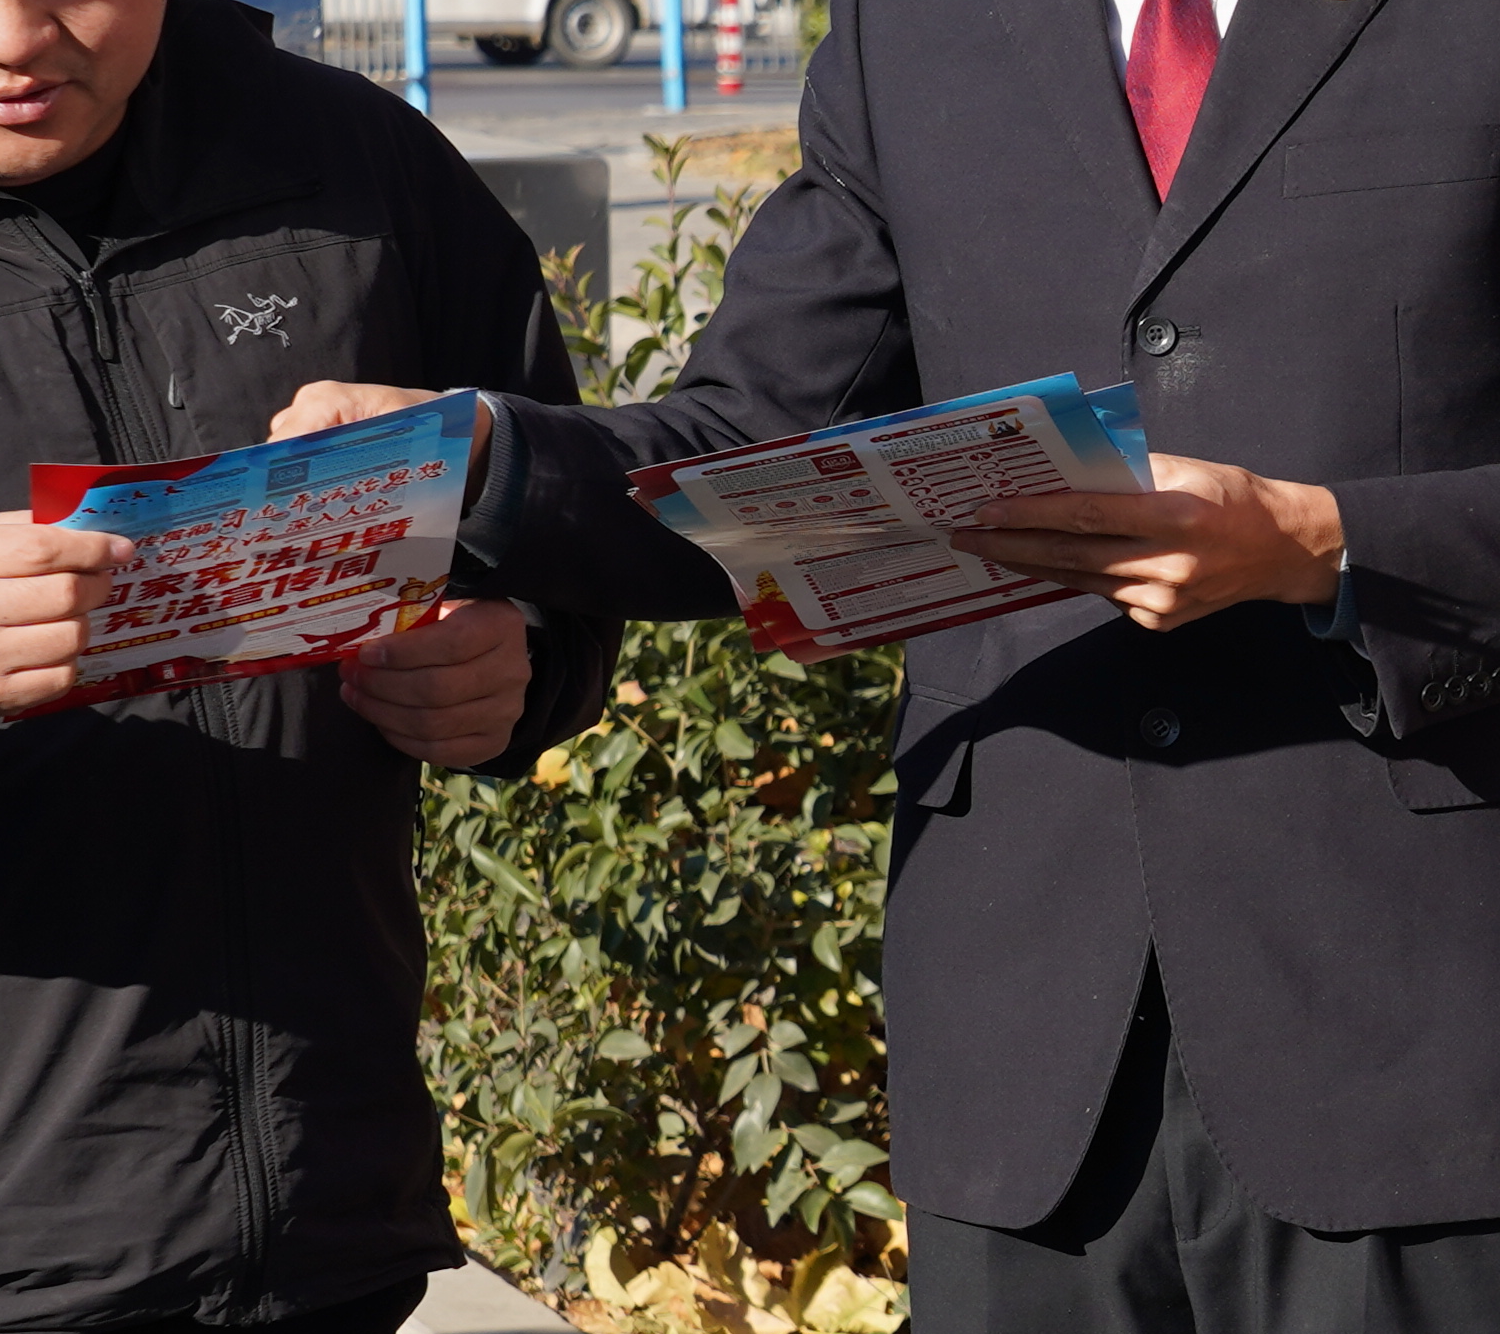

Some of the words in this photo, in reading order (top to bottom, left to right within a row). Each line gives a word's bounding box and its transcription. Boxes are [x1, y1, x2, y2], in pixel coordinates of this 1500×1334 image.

[101, 549, 382, 634] 宪法宣传周
